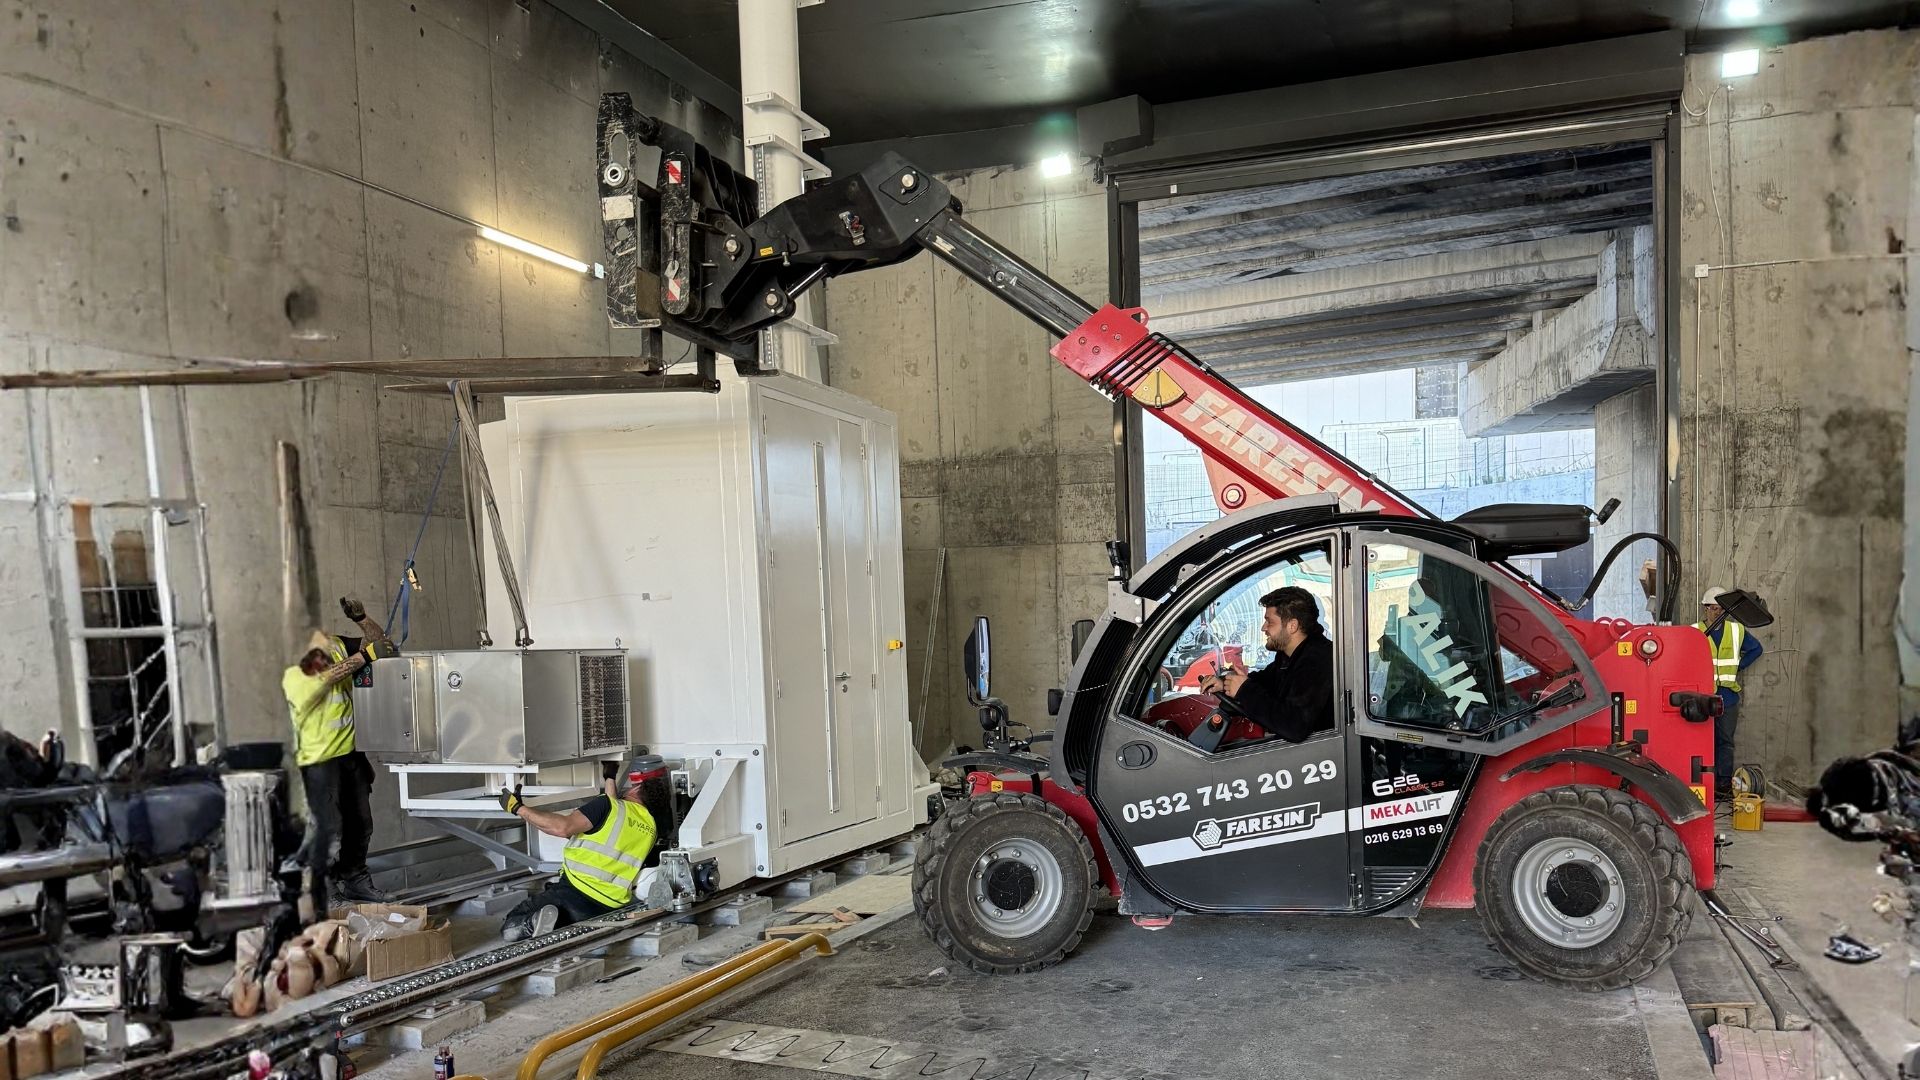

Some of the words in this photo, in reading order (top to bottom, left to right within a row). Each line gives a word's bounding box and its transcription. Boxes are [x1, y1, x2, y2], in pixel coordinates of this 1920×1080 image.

[1122, 792, 1191, 823] 0532
[1196, 779, 1249, 806] 743
[1257, 769, 1293, 794] 20
[1301, 759, 1337, 785] 29
[1372, 774, 1420, 796] 626
[1370, 798, 1441, 820] MEKALIFT
[1226, 809, 1305, 837] FARESIN
[1364, 832, 1390, 845] 0216
[1392, 828, 1413, 840] 629
[1414, 826, 1426, 837] 13
[1428, 823, 1443, 835] 69
